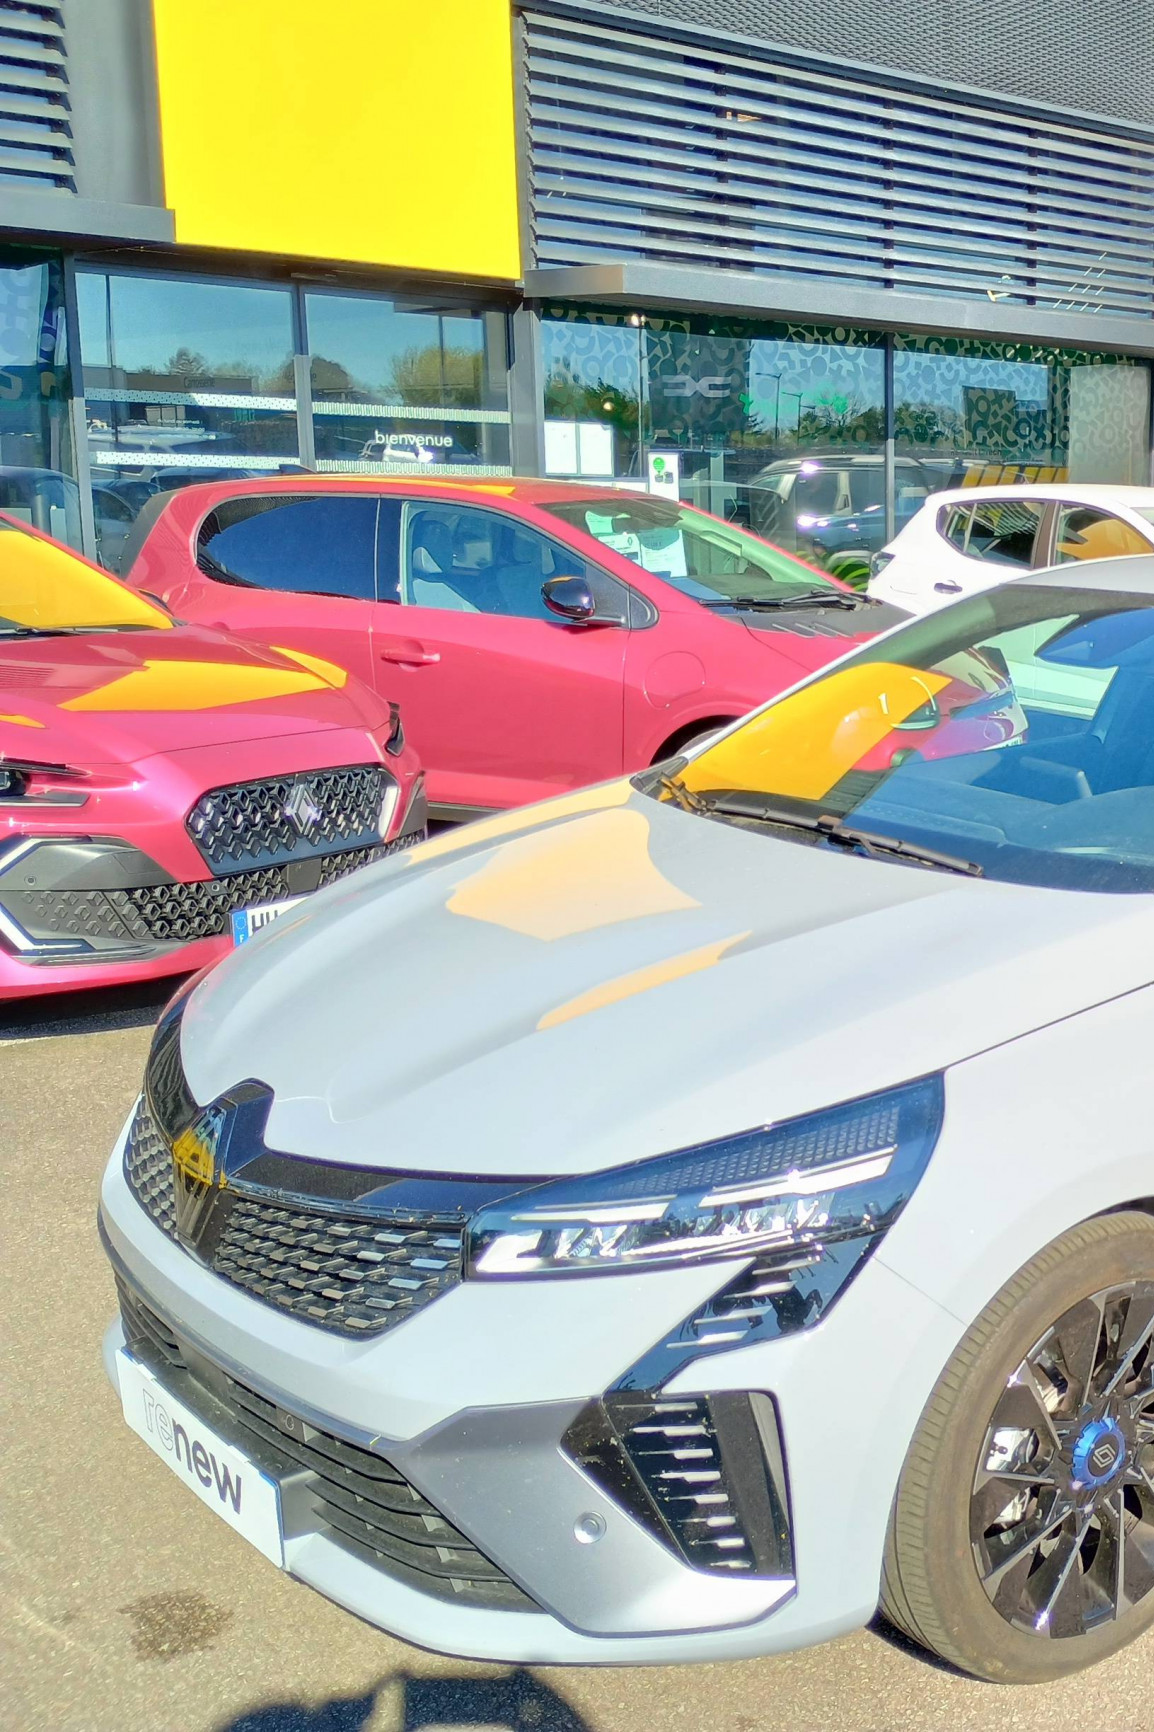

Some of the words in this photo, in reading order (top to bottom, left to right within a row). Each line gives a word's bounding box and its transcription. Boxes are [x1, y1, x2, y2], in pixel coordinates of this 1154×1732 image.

[374, 429, 453, 447] bienvenue
[239, 934, 244, 943] F
[142, 1388, 242, 1515] renew
